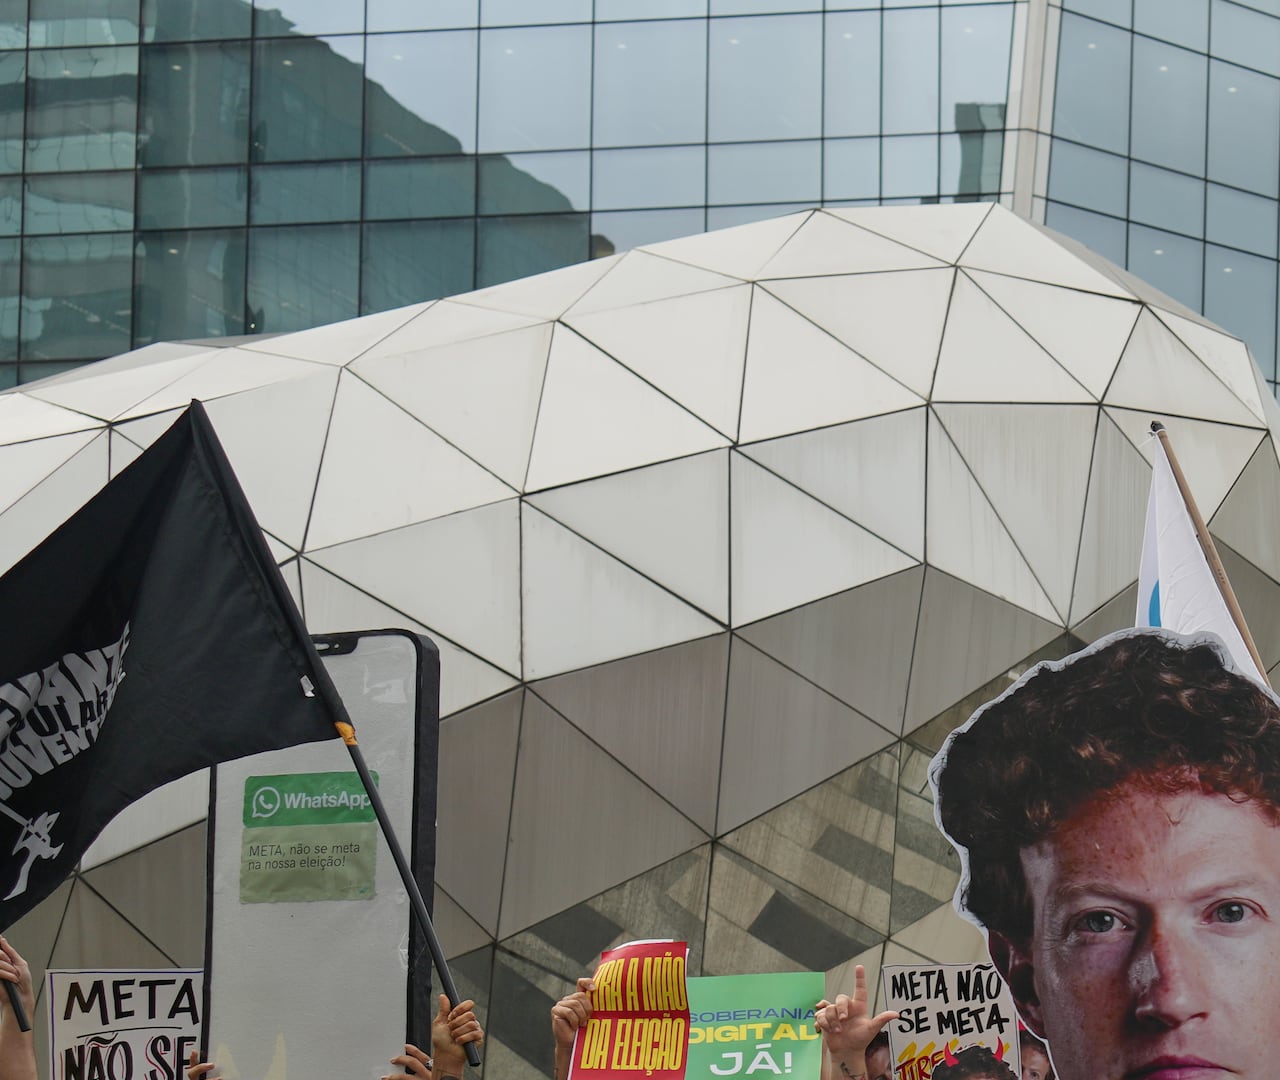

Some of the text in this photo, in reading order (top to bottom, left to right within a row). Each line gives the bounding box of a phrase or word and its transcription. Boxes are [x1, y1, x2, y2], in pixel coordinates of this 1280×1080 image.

[284, 791, 372, 810] WhatsApp
[248, 856, 346, 870] na nossa eleição!
[249, 843, 360, 857] META, não se meta
[627, 952, 687, 1012] A MÃO
[892, 964, 1001, 1004] META NÃO
[64, 979, 200, 1026] META
[690, 1007, 816, 1023] SOBERANIA
[689, 1023, 820, 1044] DIGITAL
[898, 1004, 1009, 1036] SE META
[581, 1013, 685, 1076] DA ELEIÇÃO
[710, 1043, 791, 1075] JÁ!
